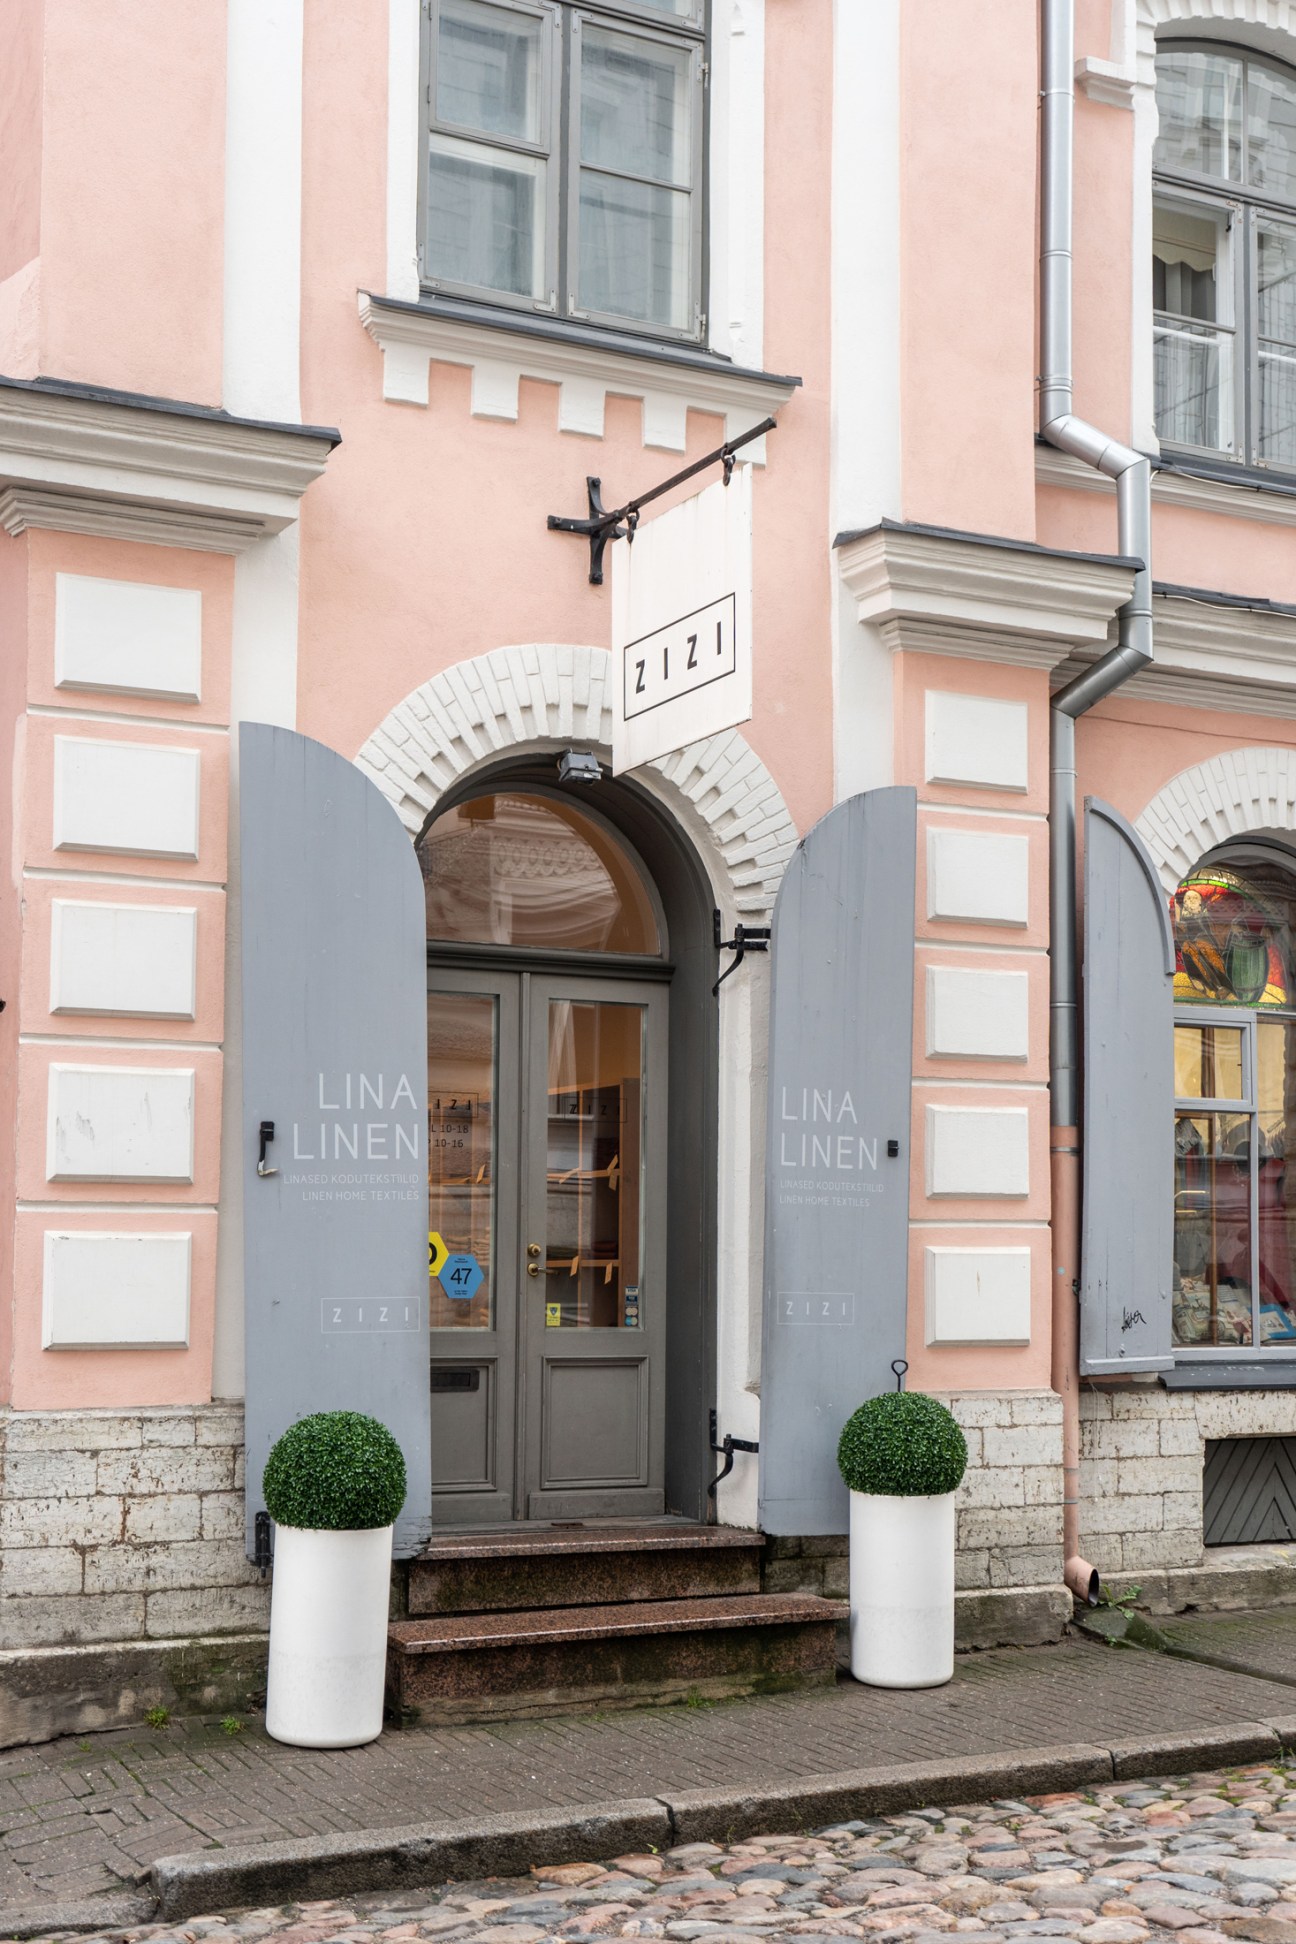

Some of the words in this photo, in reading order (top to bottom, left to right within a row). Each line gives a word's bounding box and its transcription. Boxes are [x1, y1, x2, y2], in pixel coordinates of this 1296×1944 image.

[635, 620, 722, 695] ZIZI
[318, 1072, 418, 1110] LINA
[436, 1098, 471, 1111] IZI
[781, 1086, 858, 1125] LINA
[440, 1124, 469, 1134] 10-18
[293, 1123, 419, 1160] LINEN
[435, 1138, 464, 1148] 10-16
[780, 1132, 878, 1171] LINEN
[283, 1174, 329, 1185] LINASED
[331, 1173, 419, 1184] KODUTEKSTIILID
[780, 1179, 815, 1190] LINASED
[816, 1181, 885, 1193] KODUTEKSTIILID
[302, 1190, 332, 1201] LINEN
[335, 1190, 367, 1201] HOME
[370, 1190, 419, 1201] TEXTILES
[779, 1194, 803, 1204] LINEN
[804, 1195, 830, 1206] HOME
[831, 1196, 871, 1207] TEXTILES
[450, 1267, 473, 1285] 47
[332, 1306, 409, 1323] ZIZI
[785, 1301, 847, 1316] ZIZI
